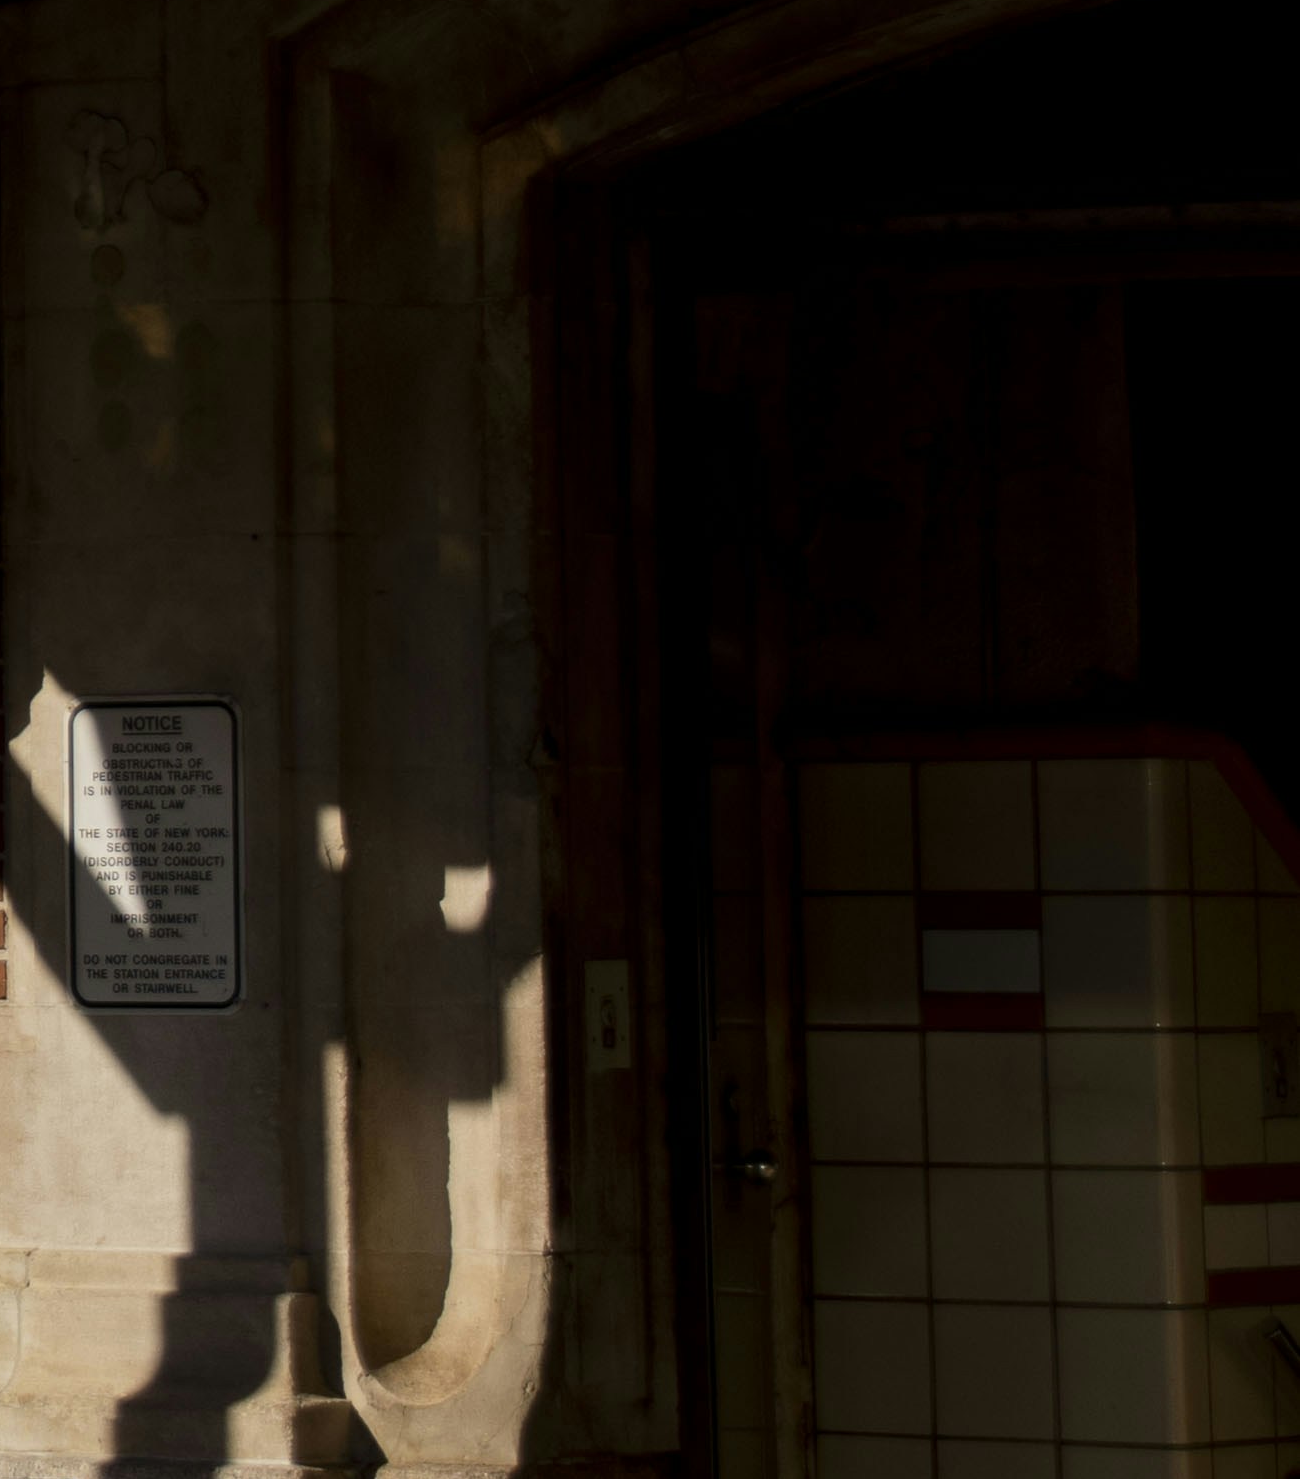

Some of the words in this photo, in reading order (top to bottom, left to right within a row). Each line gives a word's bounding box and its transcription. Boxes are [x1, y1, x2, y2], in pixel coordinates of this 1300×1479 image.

[122, 716, 182, 731] NOTICE
[112, 743, 170, 753] BLOCKING
[176, 742, 193, 753] OR
[103, 759, 182, 769] OBSTRUCTING
[188, 759, 203, 769] OF
[92, 771, 161, 782] PEDESTRIAN
[168, 770, 213, 782] TRAFFIC
[83, 786, 95, 796] IS
[100, 786, 111, 796] IN
[117, 785, 175, 796] VIOLATION
[181, 785, 196, 795] OF
[200, 785, 223, 795] THE
[121, 799, 156, 809] PENAL
[161, 799, 185, 809] LAW
[145, 813, 161, 824] OF
[79, 828, 100, 838] THE
[106, 828, 139, 838] STATE
[144, 828, 160, 838] OF
[164, 828, 191, 838] NEW
[106, 842, 156, 852] SECTION
[161, 842, 201, 852] 240.20
[83, 856, 159, 867] (DISORDERLY
[164, 856, 224, 867] CONDUCT)
[96, 871, 119, 881] AND
[125, 871, 136, 881] IS
[142, 870, 213, 881] PUNISHABLE
[109, 885, 122, 895] BY
[128, 885, 168, 895] EITHER
[174, 884, 200, 895] FINE
[147, 899, 163, 909] OR
[110, 913, 198, 924] IMPRISONMENT
[127, 928, 143, 938] OR
[83, 954, 99, 965] DO
[104, 954, 127, 965] NOT
[132, 954, 210, 965] CONGREGATE
[216, 954, 227, 965] IN
[87, 968, 107, 979] THE
[113, 968, 159, 979] STATION
[164, 968, 226, 979] ENTRANCE
[112, 983, 129, 993] OR
